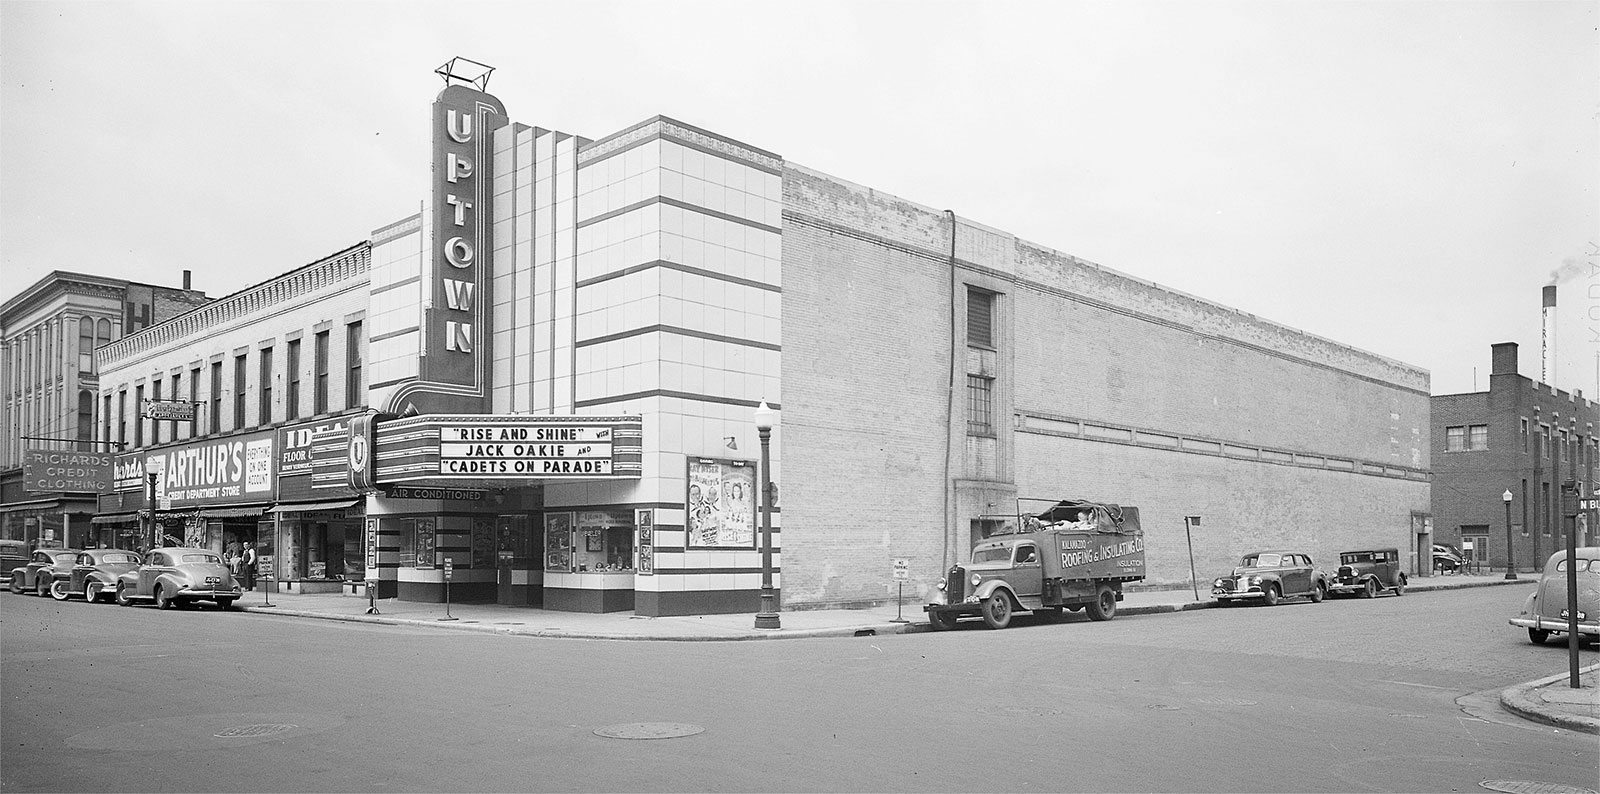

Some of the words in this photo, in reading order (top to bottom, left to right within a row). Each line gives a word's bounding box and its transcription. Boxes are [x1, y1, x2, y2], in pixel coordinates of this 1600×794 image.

[442, 109, 475, 353] UPTOWN
[454, 428, 492, 440] "RISE
[500, 429, 528, 439] AND
[536, 428, 584, 440] SHINE"
[596, 430, 609, 438] WITH
[248, 446, 270, 460] EVERYTHING
[283, 450, 306, 463] FLOOR
[466, 445, 504, 456] JACK
[514, 445, 564, 456] OAKIE
[578, 446, 591, 456] AND
[33, 454, 110, 466] RICHARDS
[167, 442, 243, 488] ARTHUR'S
[46, 467, 98, 477] CREDIT
[249, 462, 255, 473] ON
[257, 460, 266, 472] ONE
[443, 461, 506, 472] "CADETS
[514, 461, 534, 472] ON
[544, 461, 609, 472] PARADE"
[38, 480, 106, 490] CLOTHING
[248, 473, 268, 485] ACCOUNT
[168, 491, 185, 500] CREDIT
[186, 487, 220, 499] DEPARTMENT
[222, 486, 240, 497] STORE
[392, 490, 408, 498] AIR
[414, 491, 480, 500] CONDITIONED
[1580, 500, 1586, 509] N
[1062, 540, 1086, 550] KALAMAZOO
[1062, 549, 1093, 568] ROOFING
[1094, 552, 1099, 561] &
[1100, 540, 1135, 560] INSULATING
[1116, 560, 1143, 568] INSULATION
